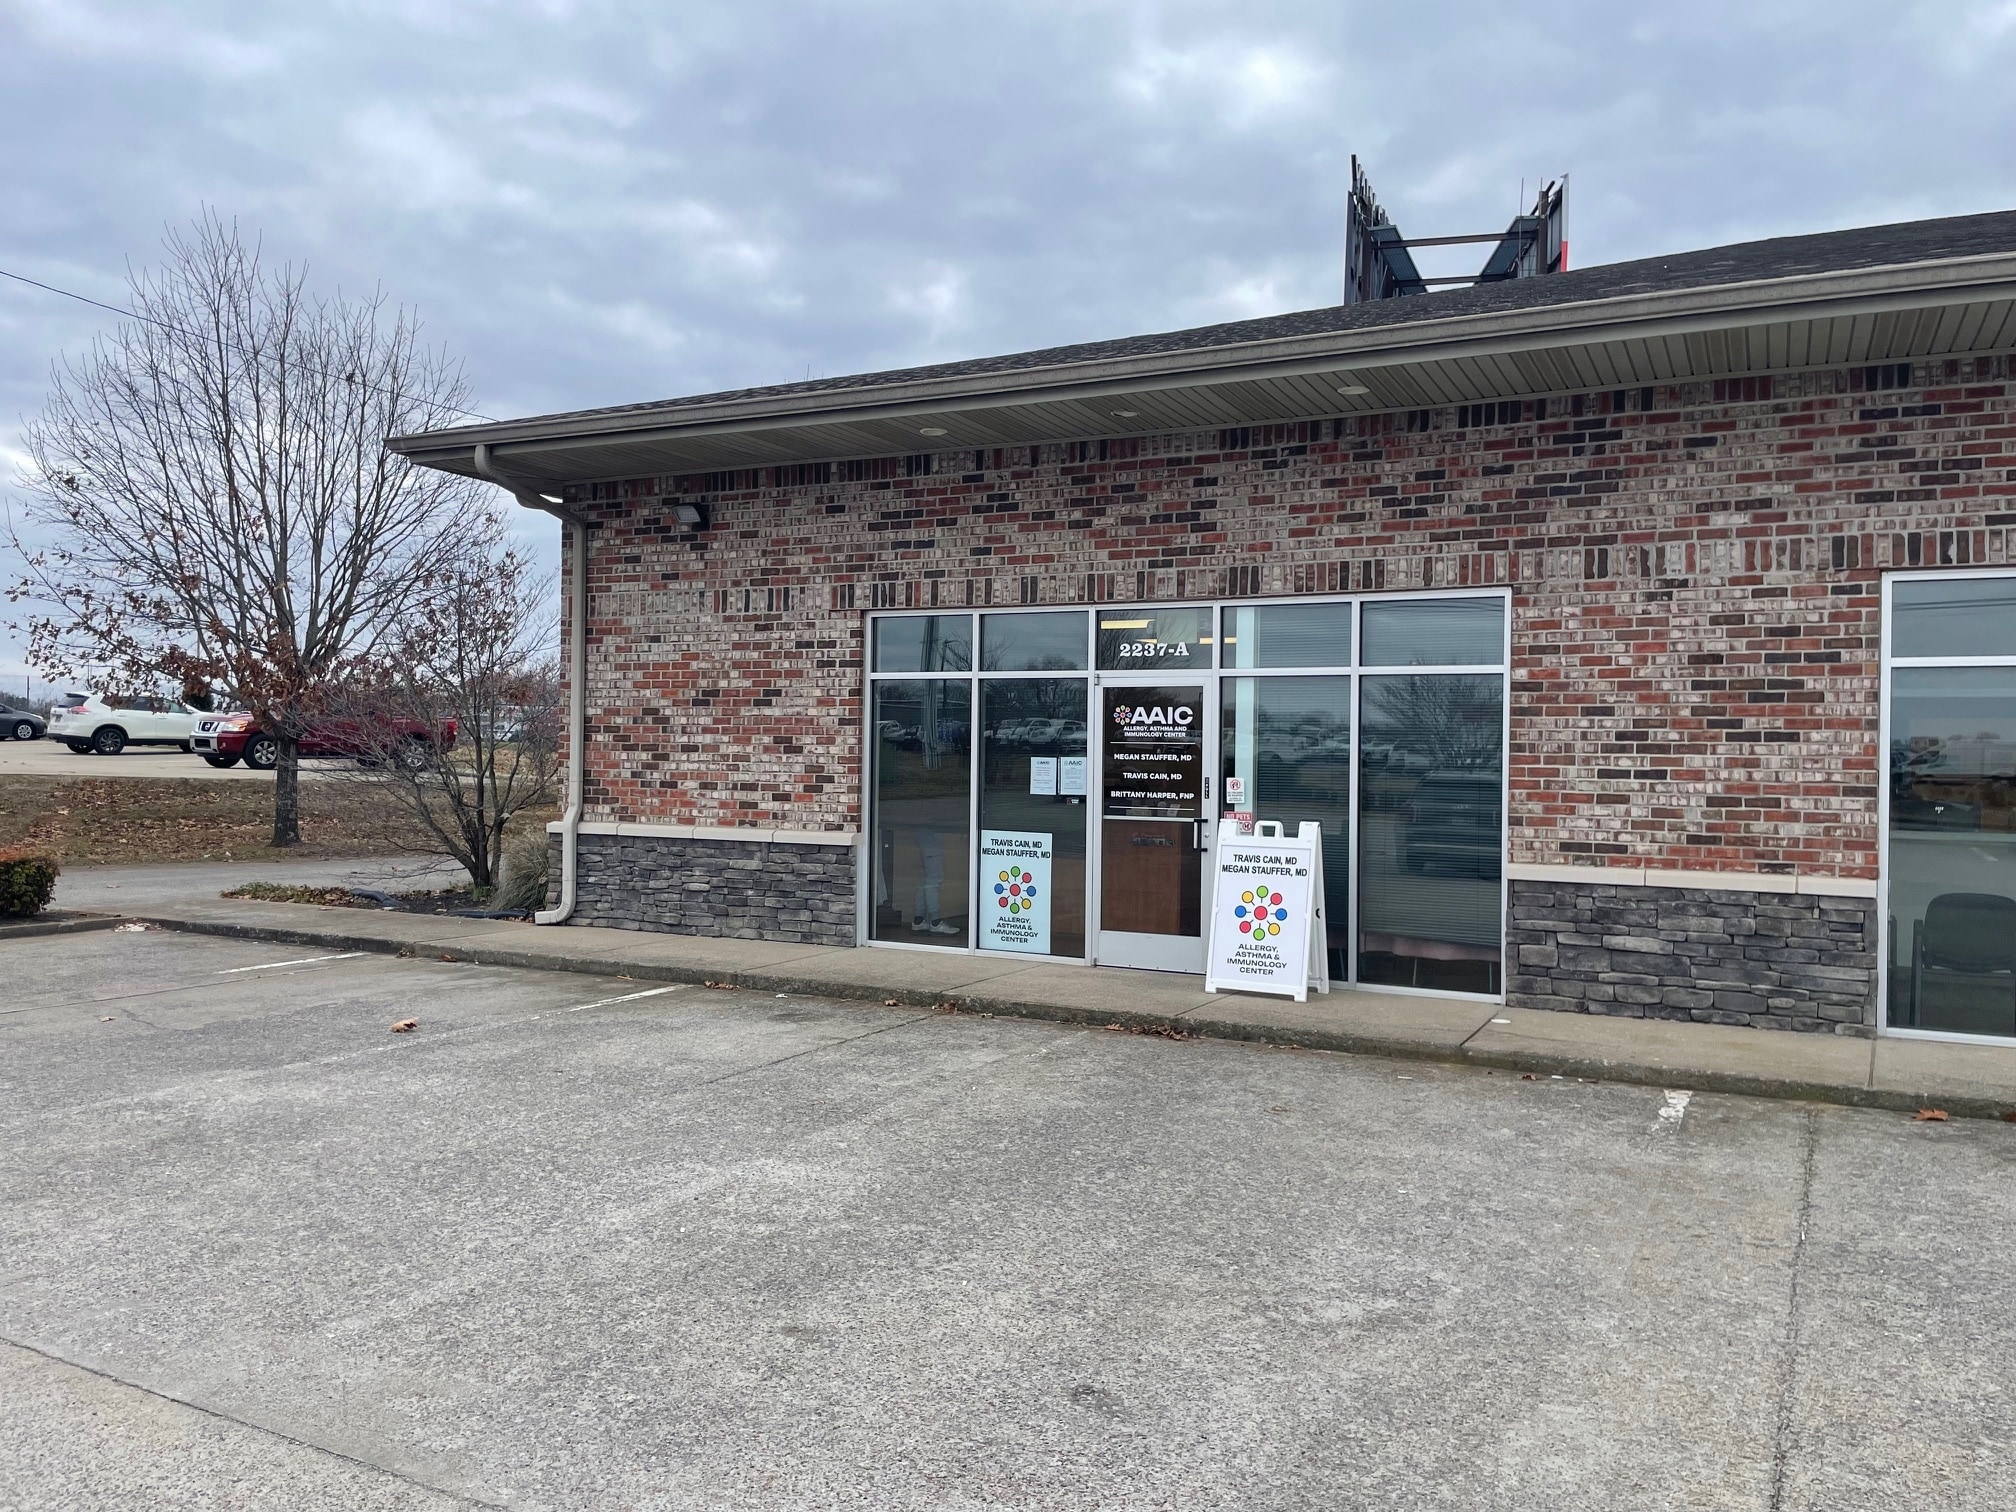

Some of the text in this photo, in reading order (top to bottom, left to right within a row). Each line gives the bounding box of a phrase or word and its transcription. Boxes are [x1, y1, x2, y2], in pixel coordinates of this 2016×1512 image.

[1119, 641, 1190, 657] 2237-A
[1130, 706, 1194, 725] AAIC
[1141, 754, 1180, 762] STAUFFER,
[1150, 772, 1170, 781] CAIN,
[1110, 790, 1195, 800] BRITTANY HARPER, FNP
[990, 838, 1043, 849] TRAVIS CAIN, MD
[982, 848, 1051, 859] MEGAN STAUFFER, MD
[1233, 854, 1298, 865] TRAVIS CAIN, MD
[1221, 864, 1308, 877] MEGAN STAUFFER, MD
[998, 916, 1032, 924] ALLERGY,
[996, 922, 1026, 930] ASTHMA
[990, 928, 1039, 938] IMMUNOLOGY
[1000, 935, 1028, 944] CENTER
[1238, 943, 1279, 953] ALLERGY,
[1234, 951, 1272, 960] ASTHMA
[1226, 958, 1287, 969] IMMUNOLOGY
[1239, 967, 1274, 976] CENTER
